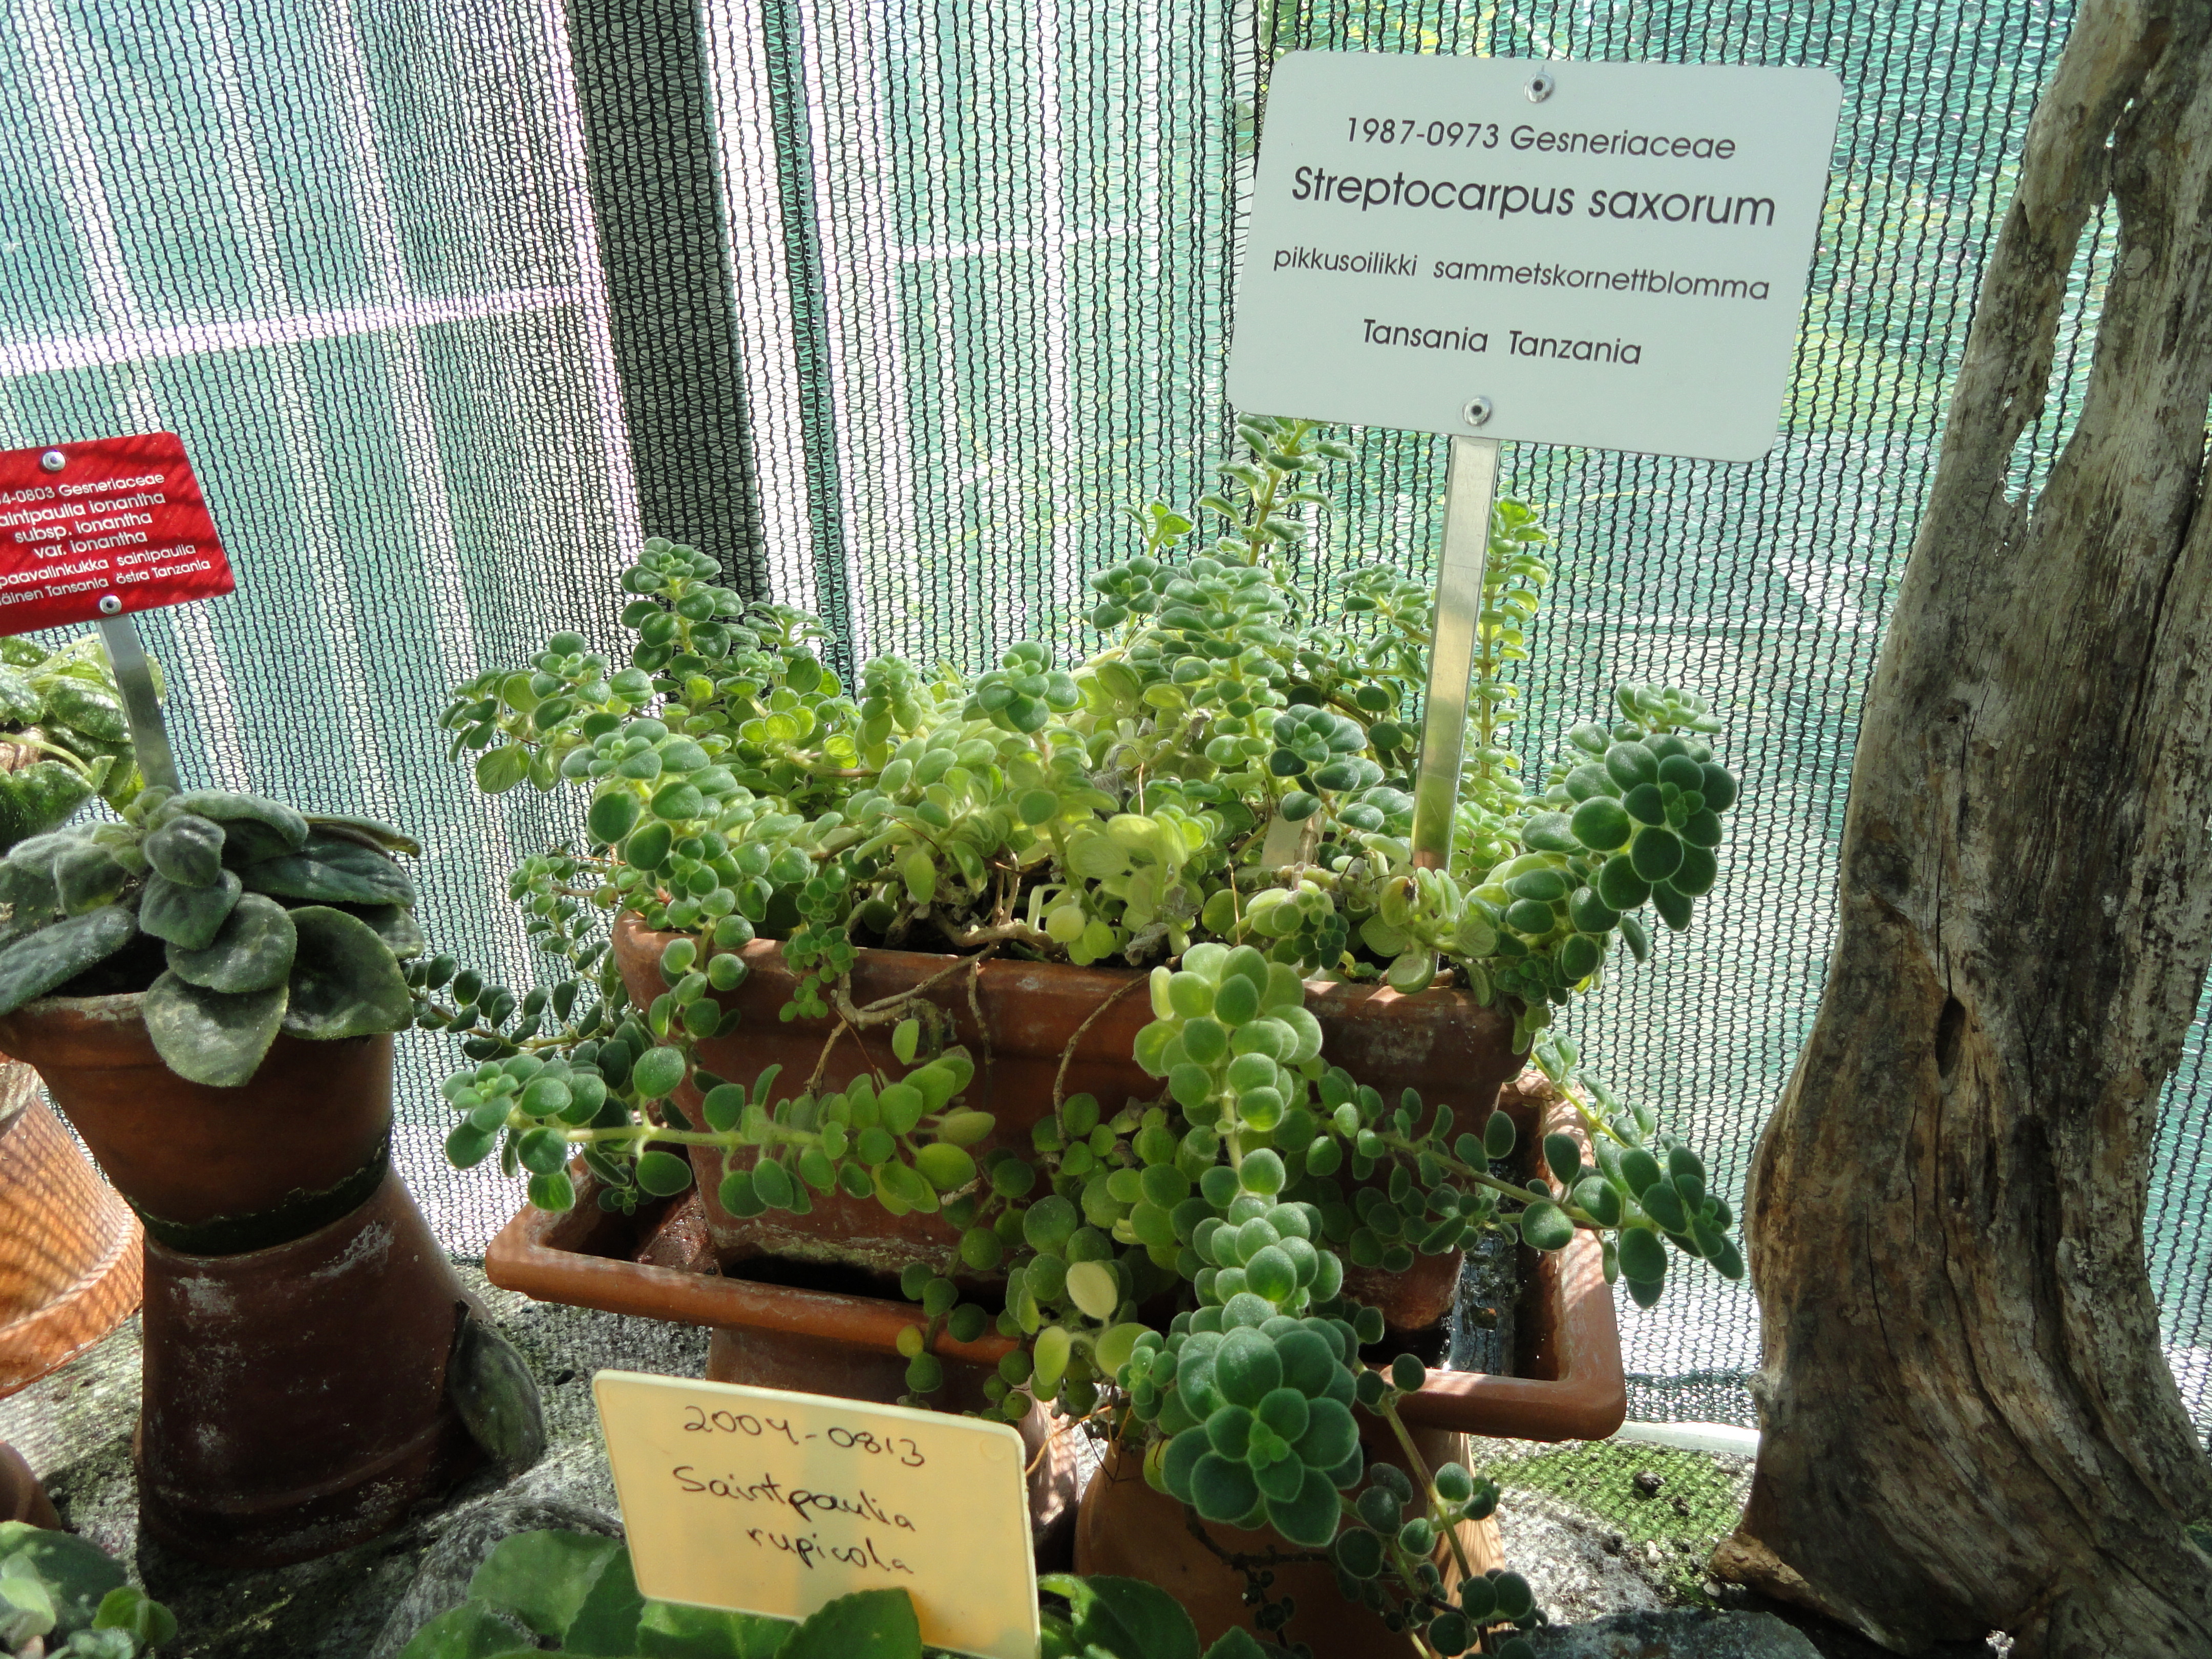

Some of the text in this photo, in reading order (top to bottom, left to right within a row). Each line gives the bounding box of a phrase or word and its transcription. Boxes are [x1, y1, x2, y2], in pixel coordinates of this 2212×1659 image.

[1347, 117, 1736, 160] 1987-0973 Gesneriaceae
[1291, 165, 1775, 226] Streptocarpus saxorum
[1273, 246, 1770, 300] pikkusoilikki sammetskornettblomma
[1363, 318, 1642, 365] Tansania Tanzania
[0, 474, 165, 506] 4-0803 Gesneriaceae
[89, 493, 166, 514] ionantha
[14, 512, 153, 543] subsp. ionantha
[33, 531, 148, 559] var. ionantha
[0, 544, 196, 589] paavalinkukka saintpaulia
[45, 577, 109, 597] Tansania
[116, 570, 150, 584] östra
[151, 559, 211, 579] Tanzania
[684, 1405, 926, 1468] 2004-0813
[672, 1465, 917, 1533] Saintpaulia
[746, 1526, 914, 1575] rupicola
